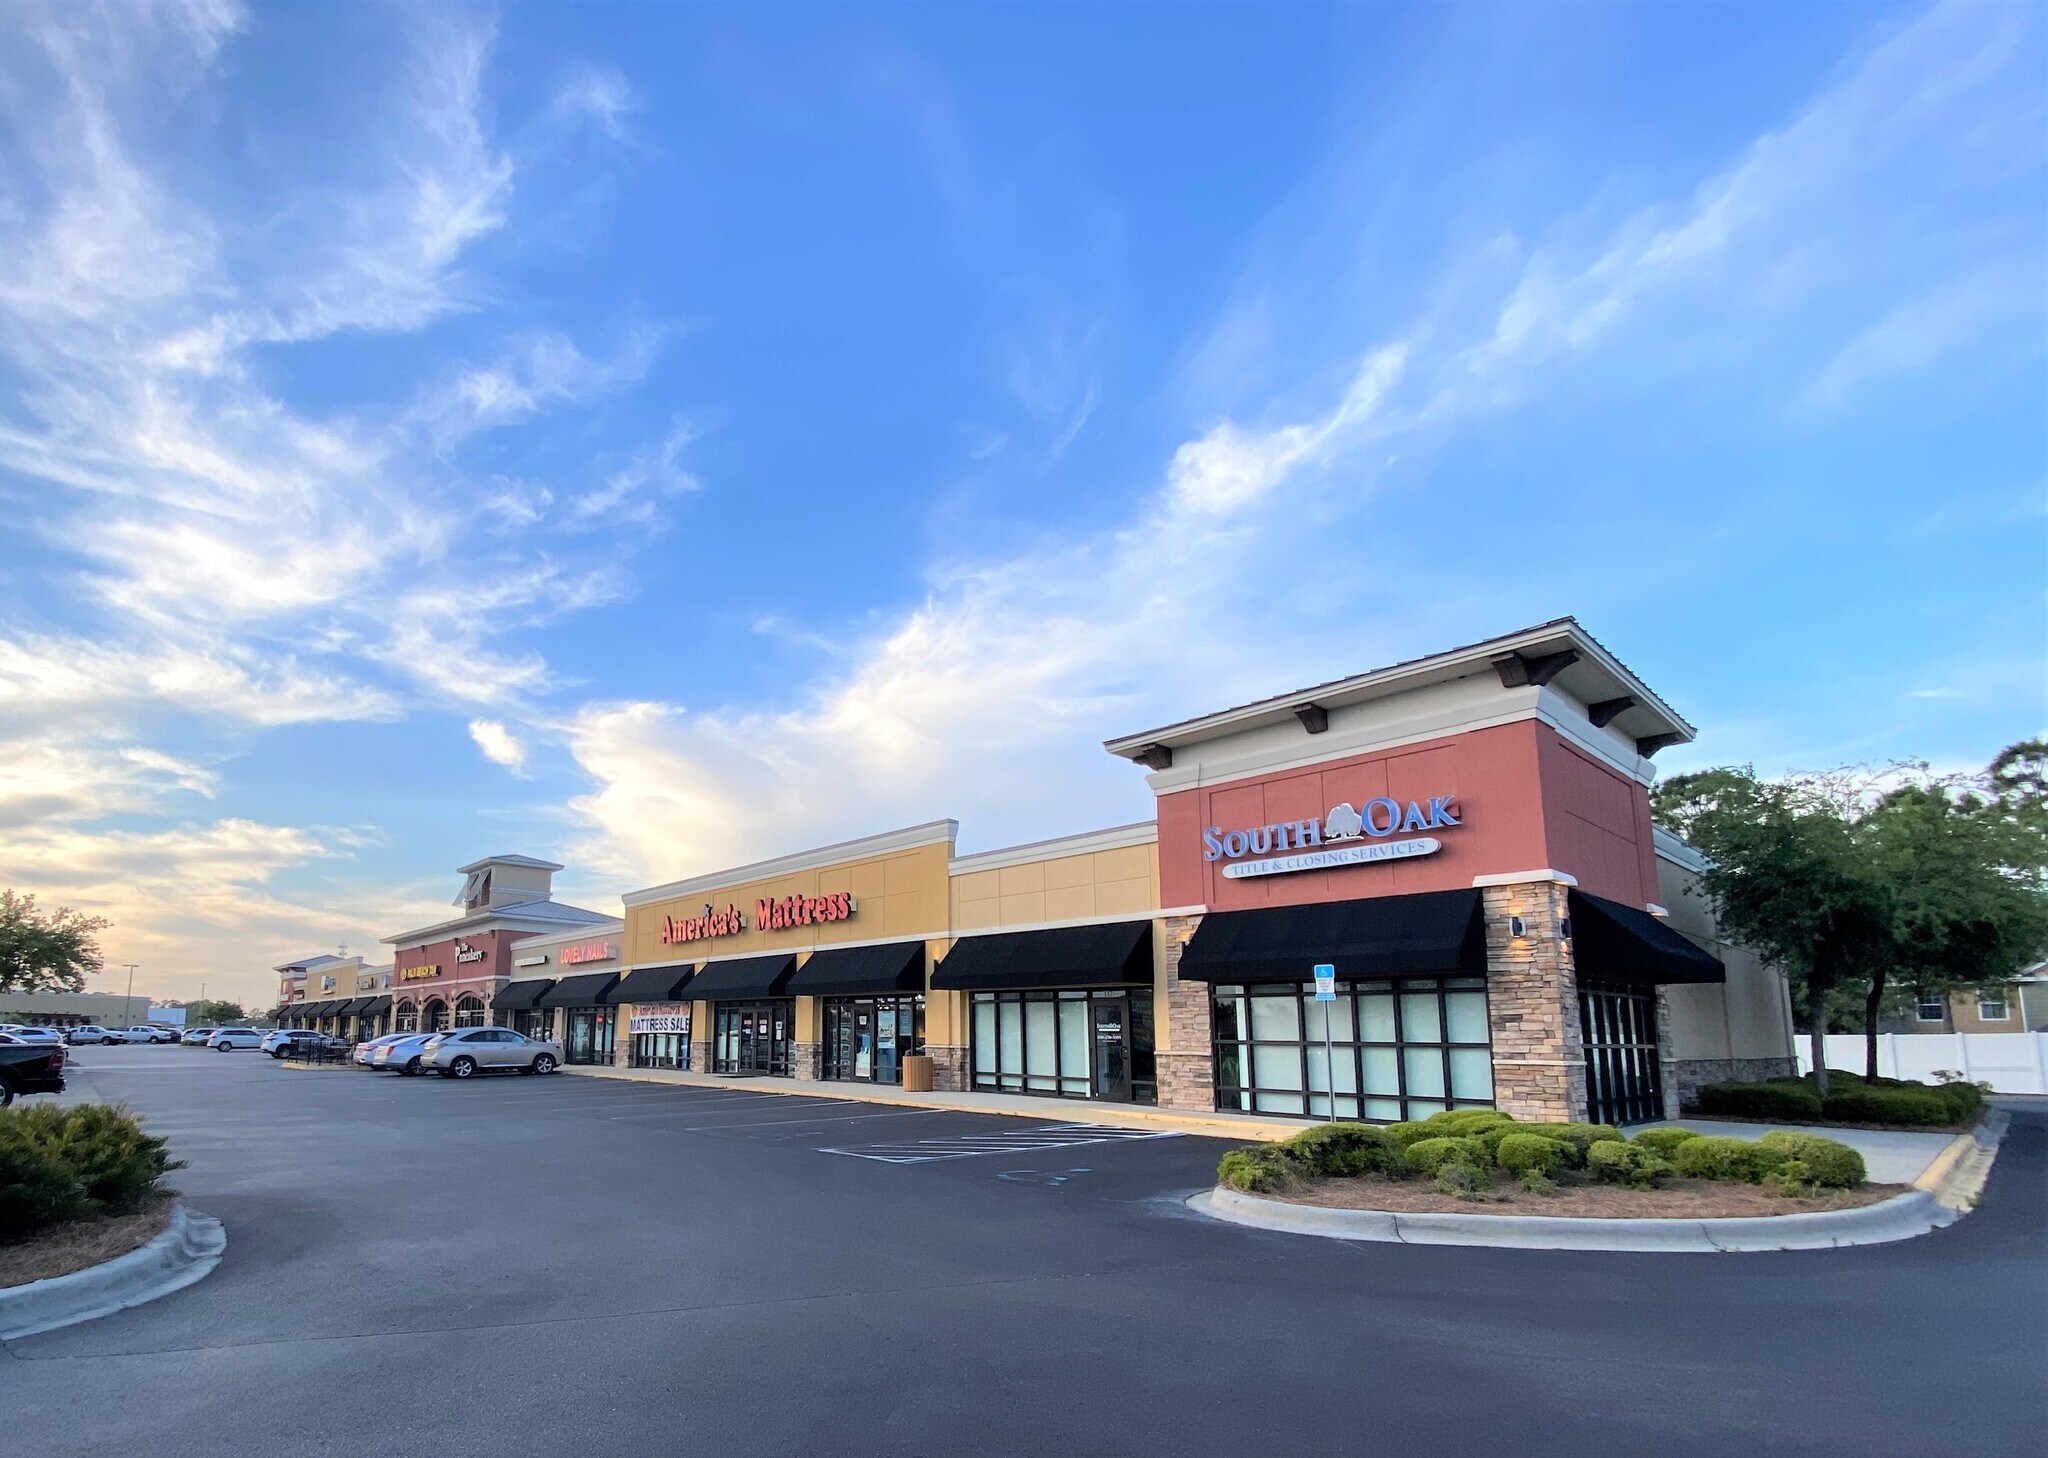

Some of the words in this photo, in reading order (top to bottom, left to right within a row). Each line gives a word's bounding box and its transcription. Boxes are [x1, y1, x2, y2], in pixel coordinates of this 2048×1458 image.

[1203, 817, 1326, 862] SOUTH
[1361, 795, 1462, 837] OAK
[1231, 862, 1270, 876] TITLE
[1272, 859, 1284, 871] &
[1286, 850, 1349, 870] CLOSING
[1352, 840, 1426, 861] SERVICES
[661, 903, 742, 944] America's
[755, 892, 853, 931] Mattress
[560, 946, 586, 964] LOVELY
[586, 942, 609, 960] NAILS
[630, 1018, 669, 1032] MATTRESS
[670, 1017, 690, 1031] SALE
